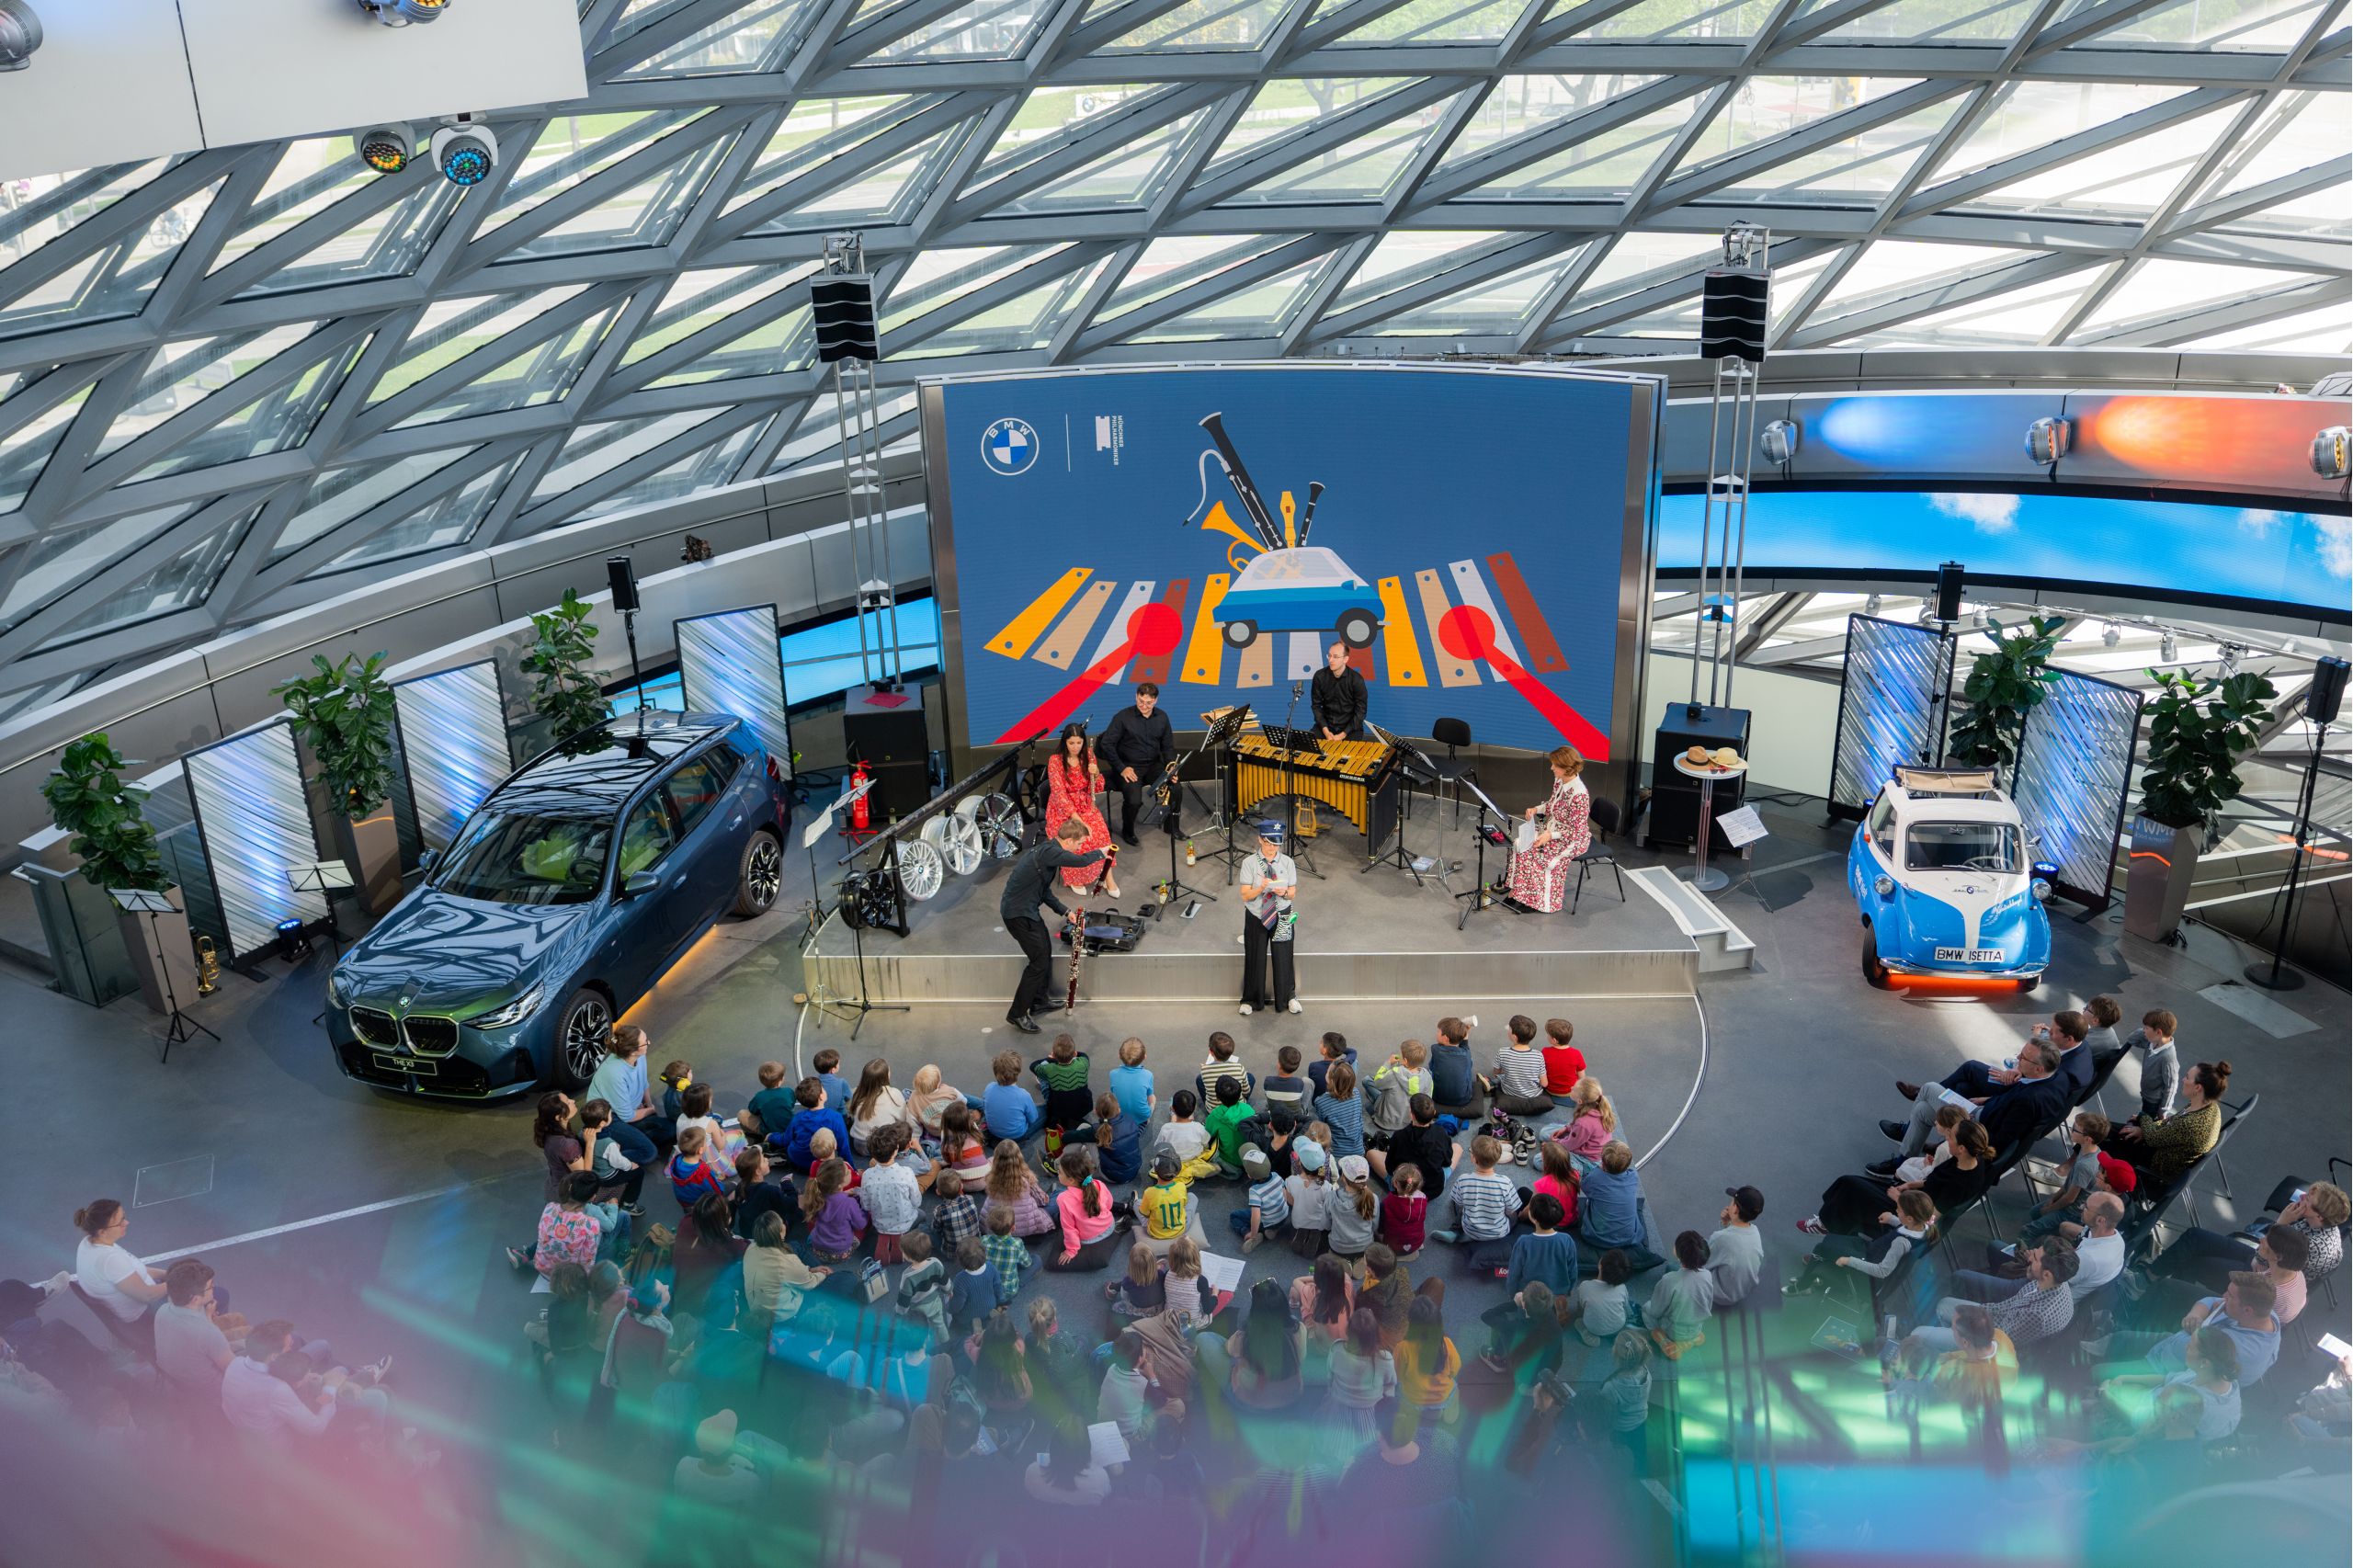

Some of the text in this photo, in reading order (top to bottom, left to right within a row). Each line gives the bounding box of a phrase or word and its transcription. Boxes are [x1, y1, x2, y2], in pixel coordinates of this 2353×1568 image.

[988, 421, 1030, 439] BMW
[1937, 949, 2002, 961] BMW ISETTA
[392, 1058, 415, 1068] THE X3
[1160, 1202, 1182, 1229] 10
